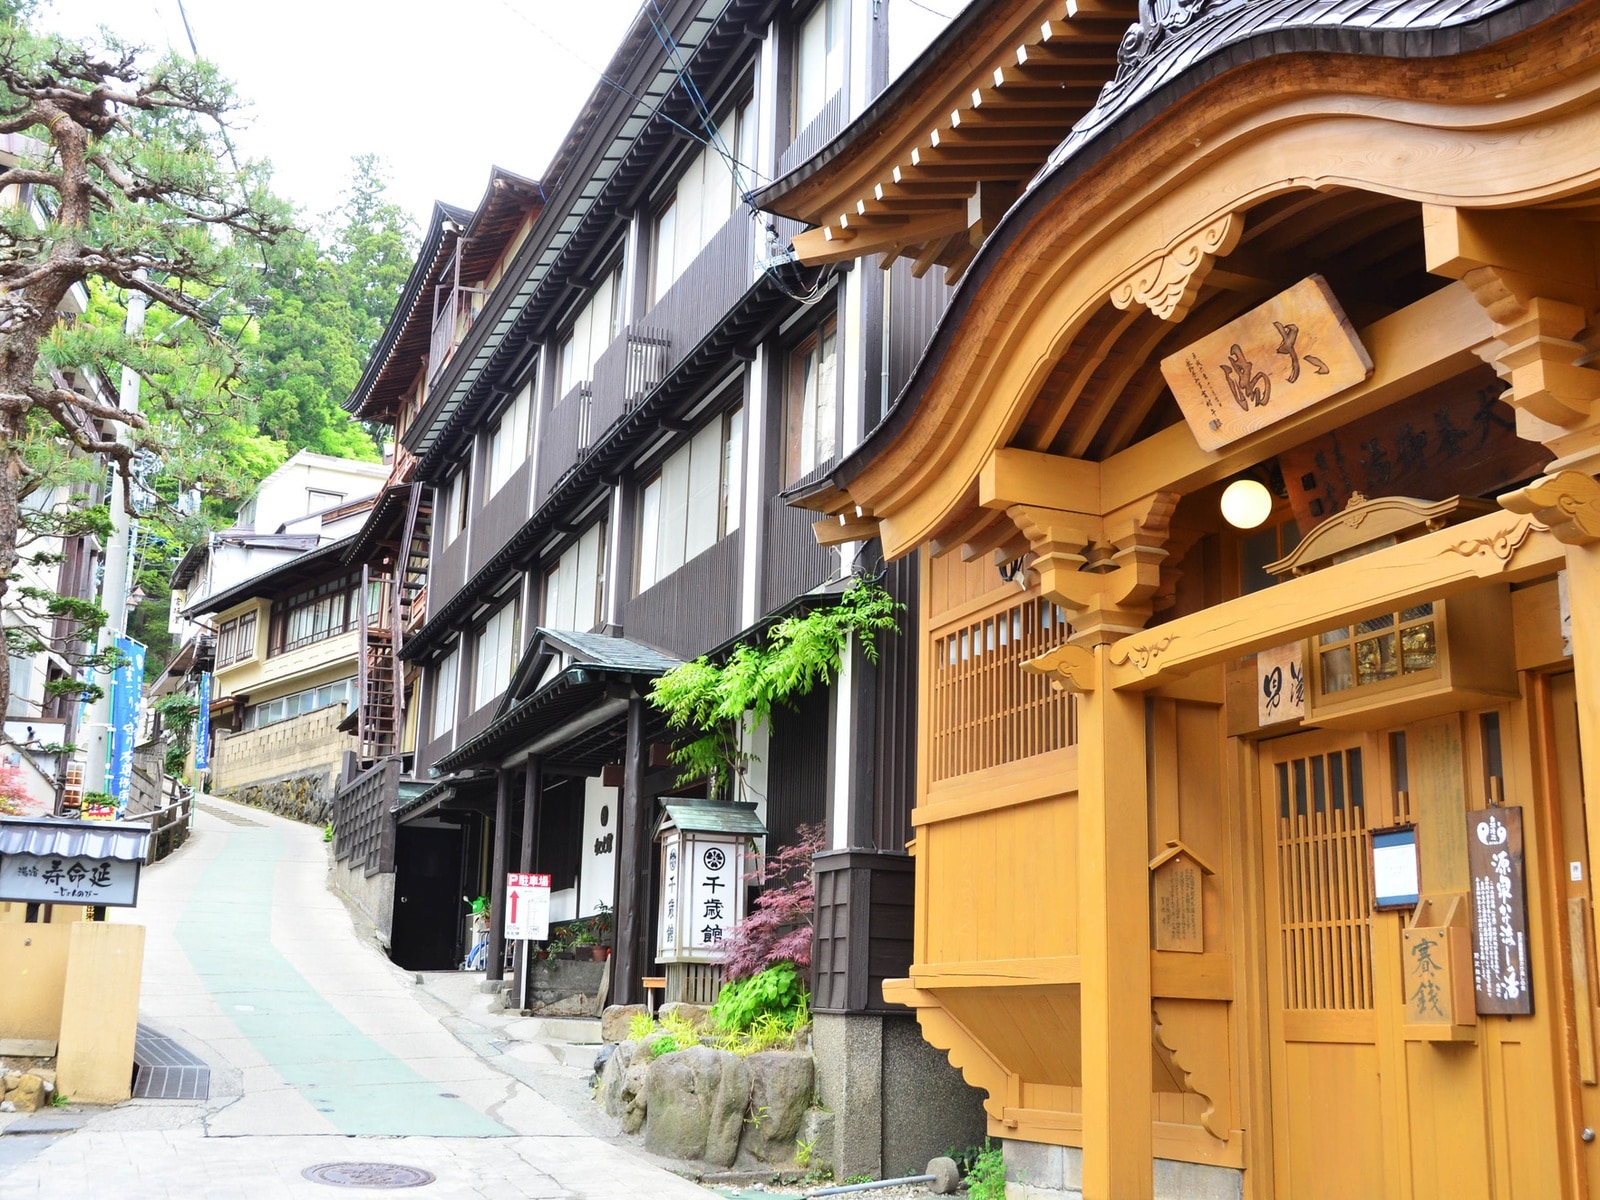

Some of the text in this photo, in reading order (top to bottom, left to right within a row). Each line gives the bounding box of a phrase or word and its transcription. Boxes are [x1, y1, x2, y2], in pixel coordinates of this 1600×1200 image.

[42, 860, 113, 888] 寿命延
[701, 875, 726, 944] 千歳館
[1490, 850, 1520, 1000] 源泉かけ流しの湯
